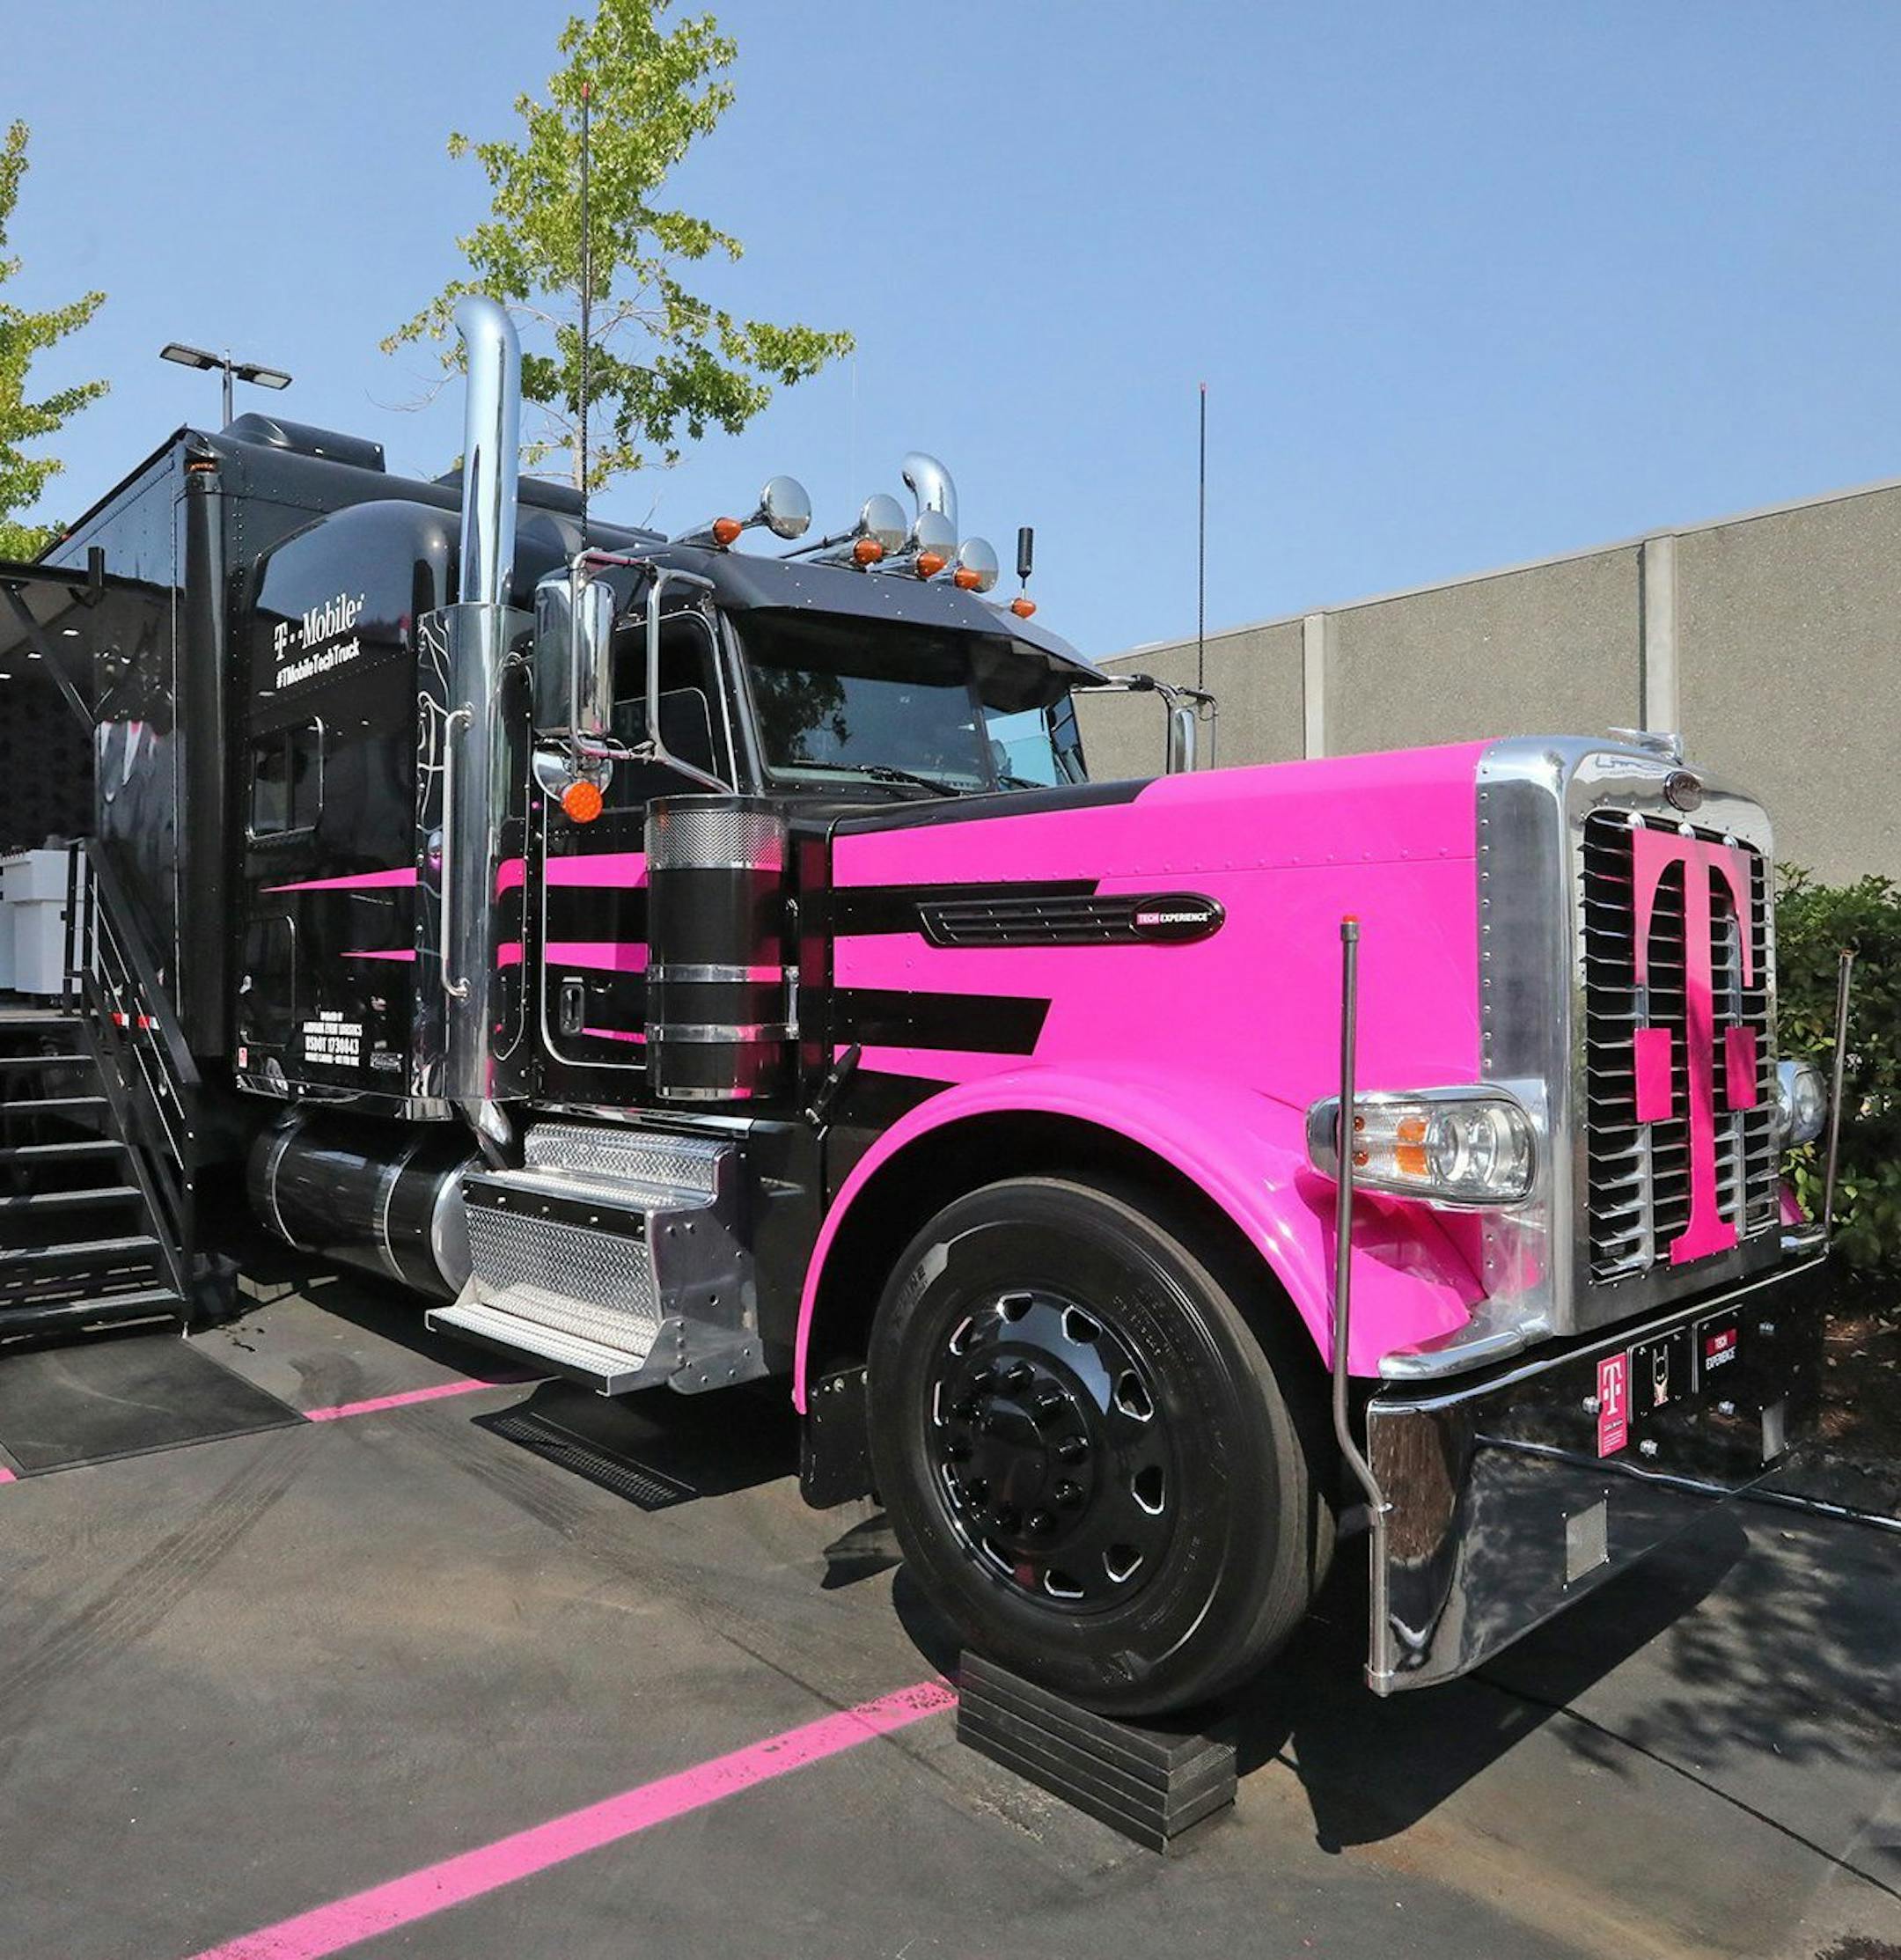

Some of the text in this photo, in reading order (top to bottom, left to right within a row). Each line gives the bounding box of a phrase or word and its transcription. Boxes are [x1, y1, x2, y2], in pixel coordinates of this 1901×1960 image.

[1137, 912, 1207, 925] TECH EXPERIENCE
[1633, 828, 1756, 1265] T
[1603, 1362, 1623, 1415] T
